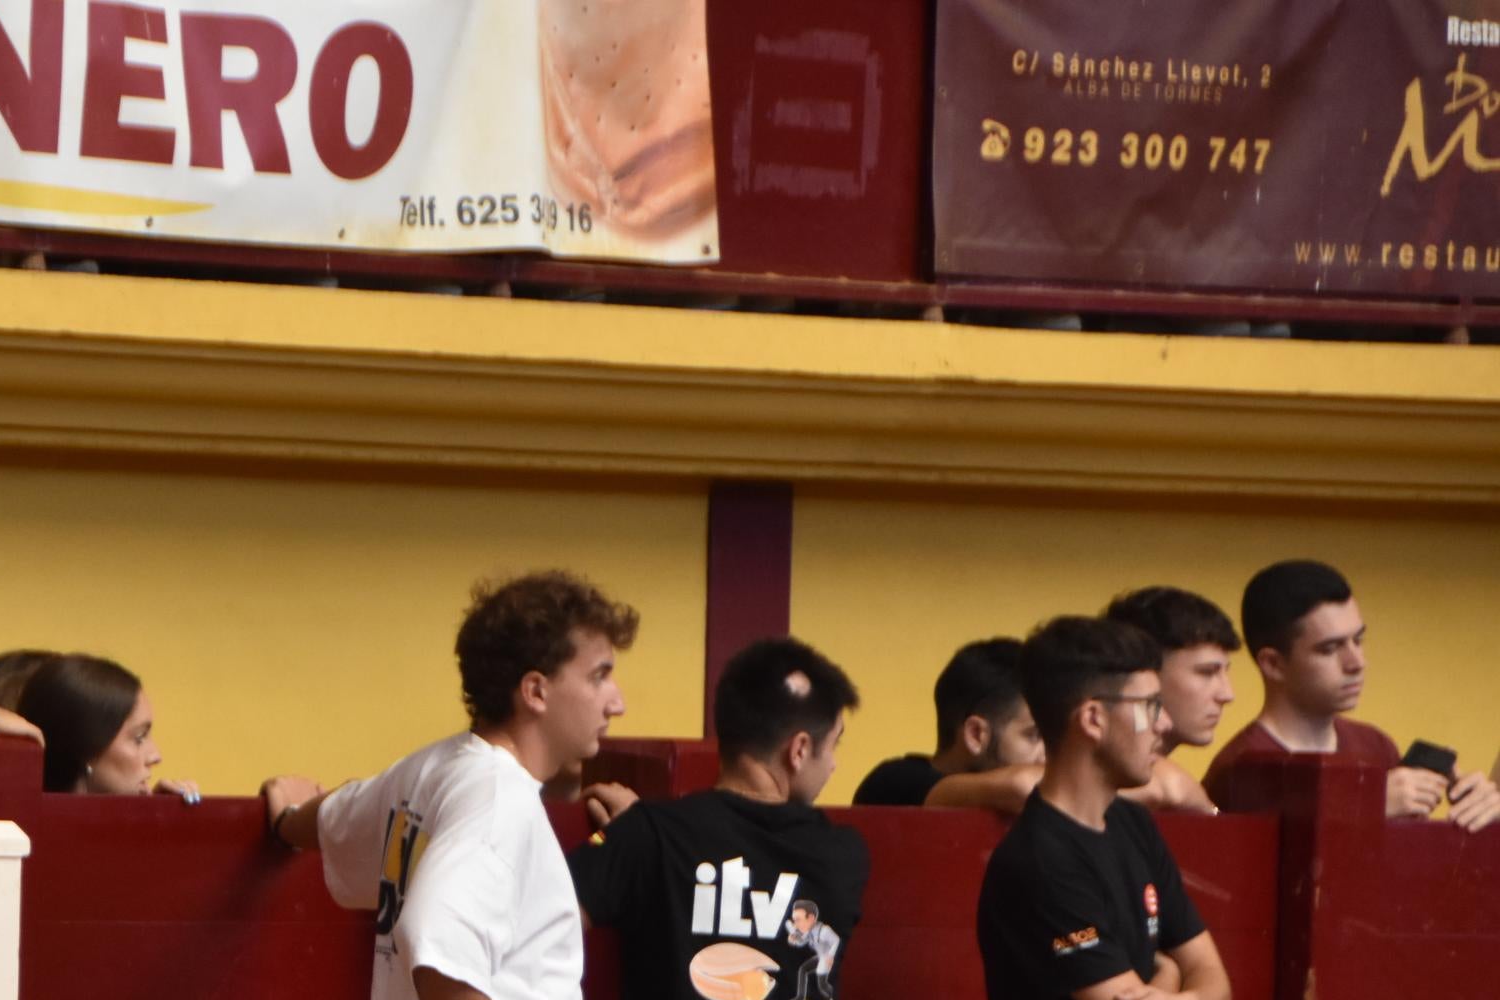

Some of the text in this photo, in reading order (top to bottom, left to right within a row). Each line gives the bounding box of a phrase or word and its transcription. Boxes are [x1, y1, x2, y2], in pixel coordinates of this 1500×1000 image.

[1052, 50, 1154, 81] Sánchez
[1022, 126, 1271, 174] 923 300 747
[399, 196, 445, 227] Telf.
[456, 195, 520, 226] 625
[566, 202, 593, 233] 16
[691, 855, 799, 940] itv
